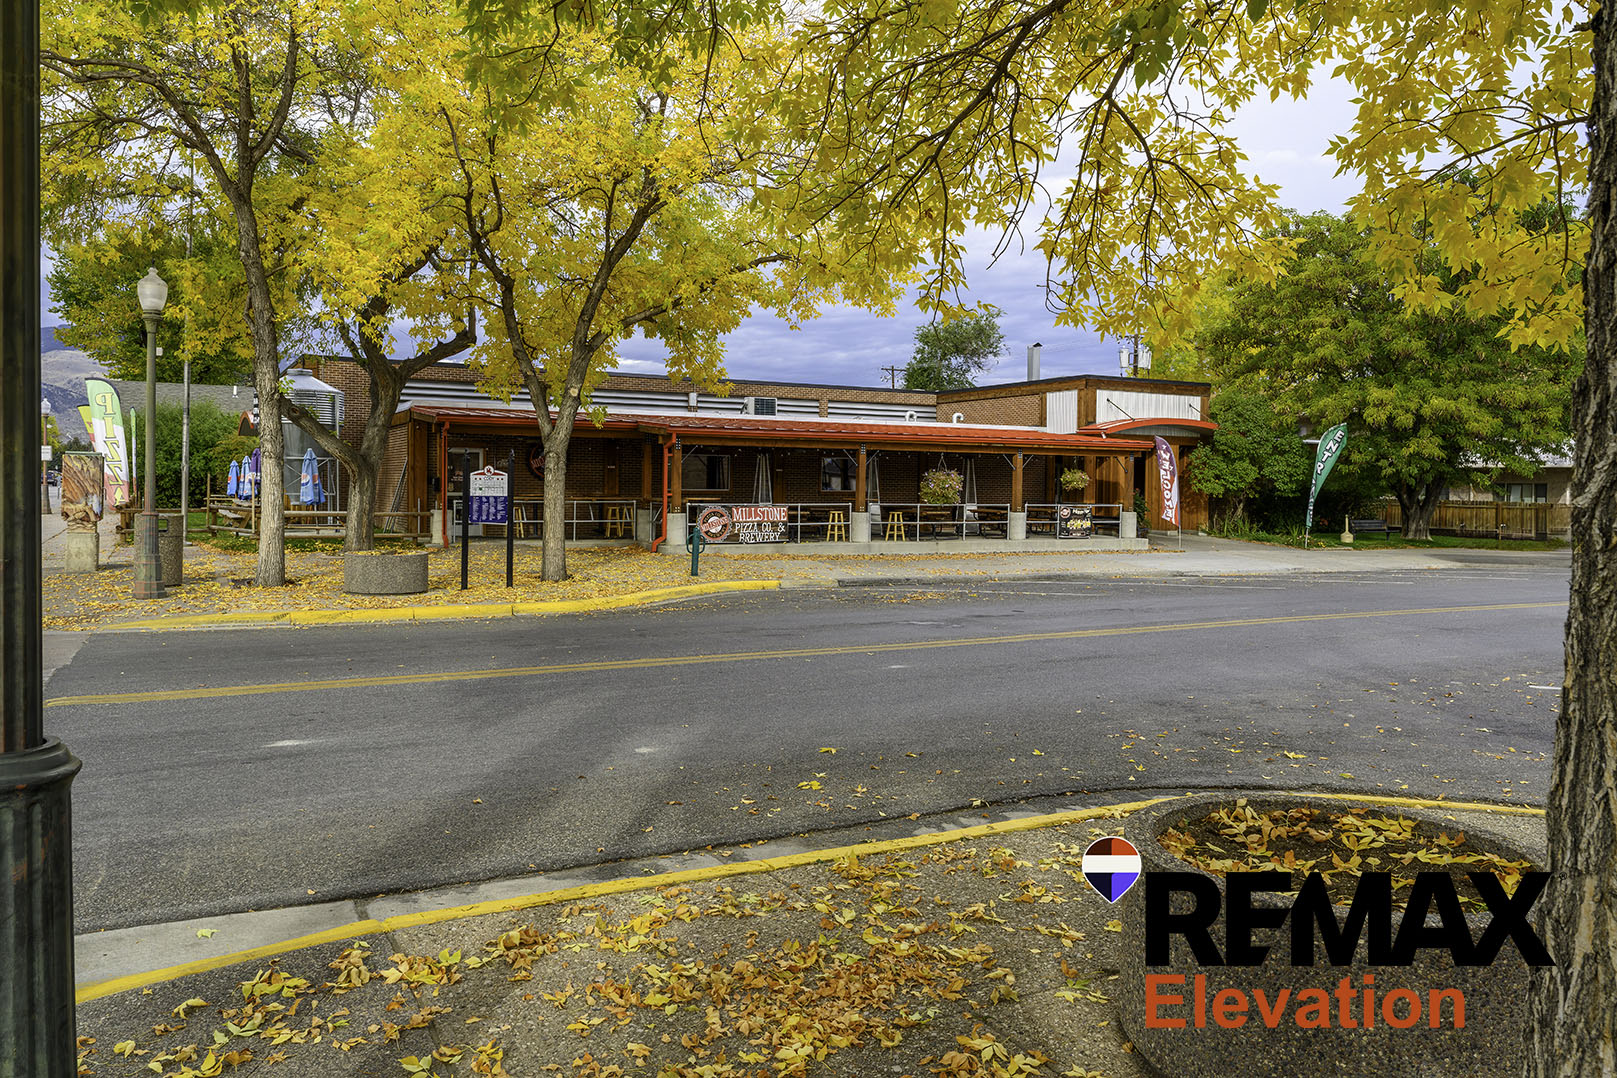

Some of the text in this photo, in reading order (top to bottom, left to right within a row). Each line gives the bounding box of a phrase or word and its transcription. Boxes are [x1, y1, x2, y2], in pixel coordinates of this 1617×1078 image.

[732, 507, 787, 521] MILLSTONE
[735, 522, 758, 533] PIZZA
[777, 522, 786, 532] &
[739, 532, 781, 543] BREWERY
